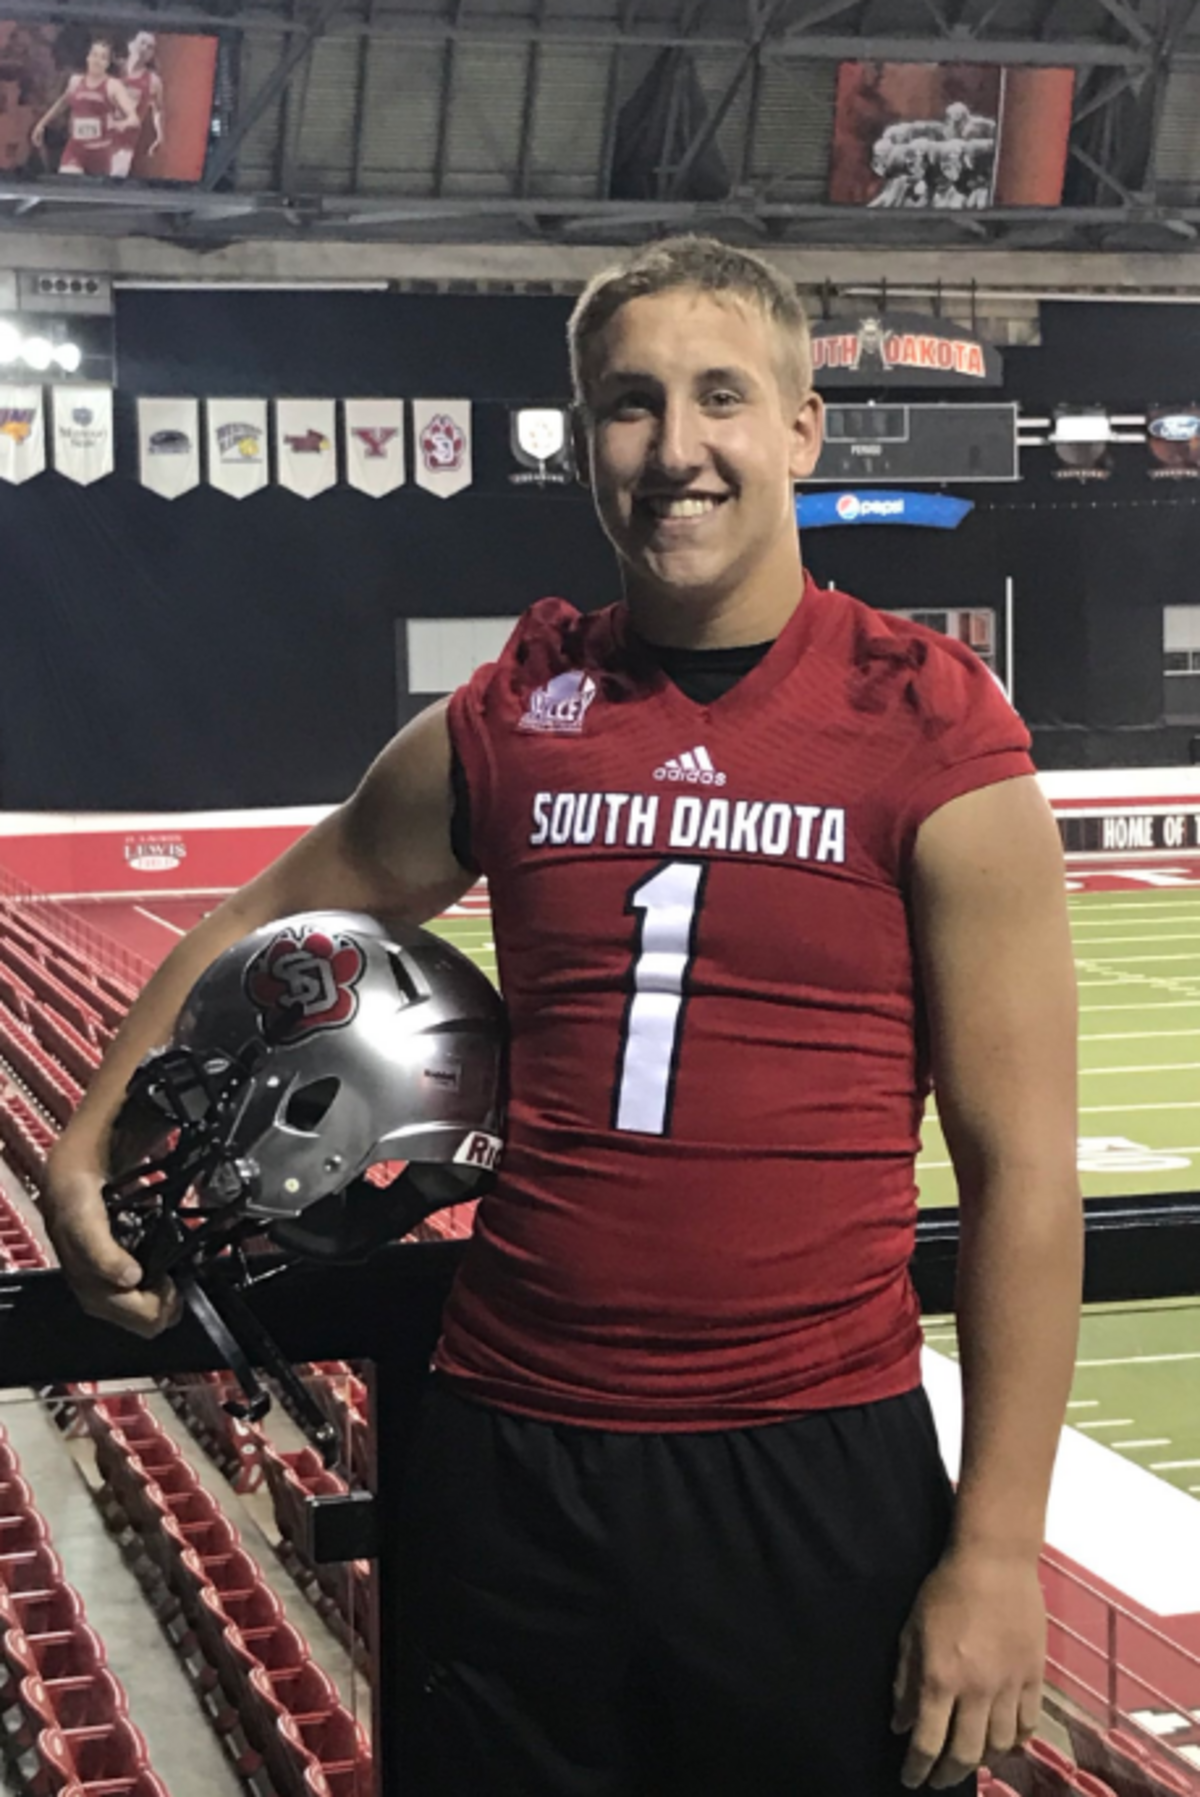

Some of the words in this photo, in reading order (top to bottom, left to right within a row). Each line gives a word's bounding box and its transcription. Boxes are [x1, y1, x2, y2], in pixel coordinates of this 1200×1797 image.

[812, 334, 858, 370] UTH
[884, 334, 986, 378] DAKOTA
[860, 499, 904, 516] pepsi
[652, 766, 727, 787] adidas
[529, 791, 659, 847] SOUTH
[668, 795, 846, 864] DAKOTA
[1102, 815, 1155, 849] HOME
[1162, 814, 1184, 847] OF
[612, 858, 706, 1137] 1
